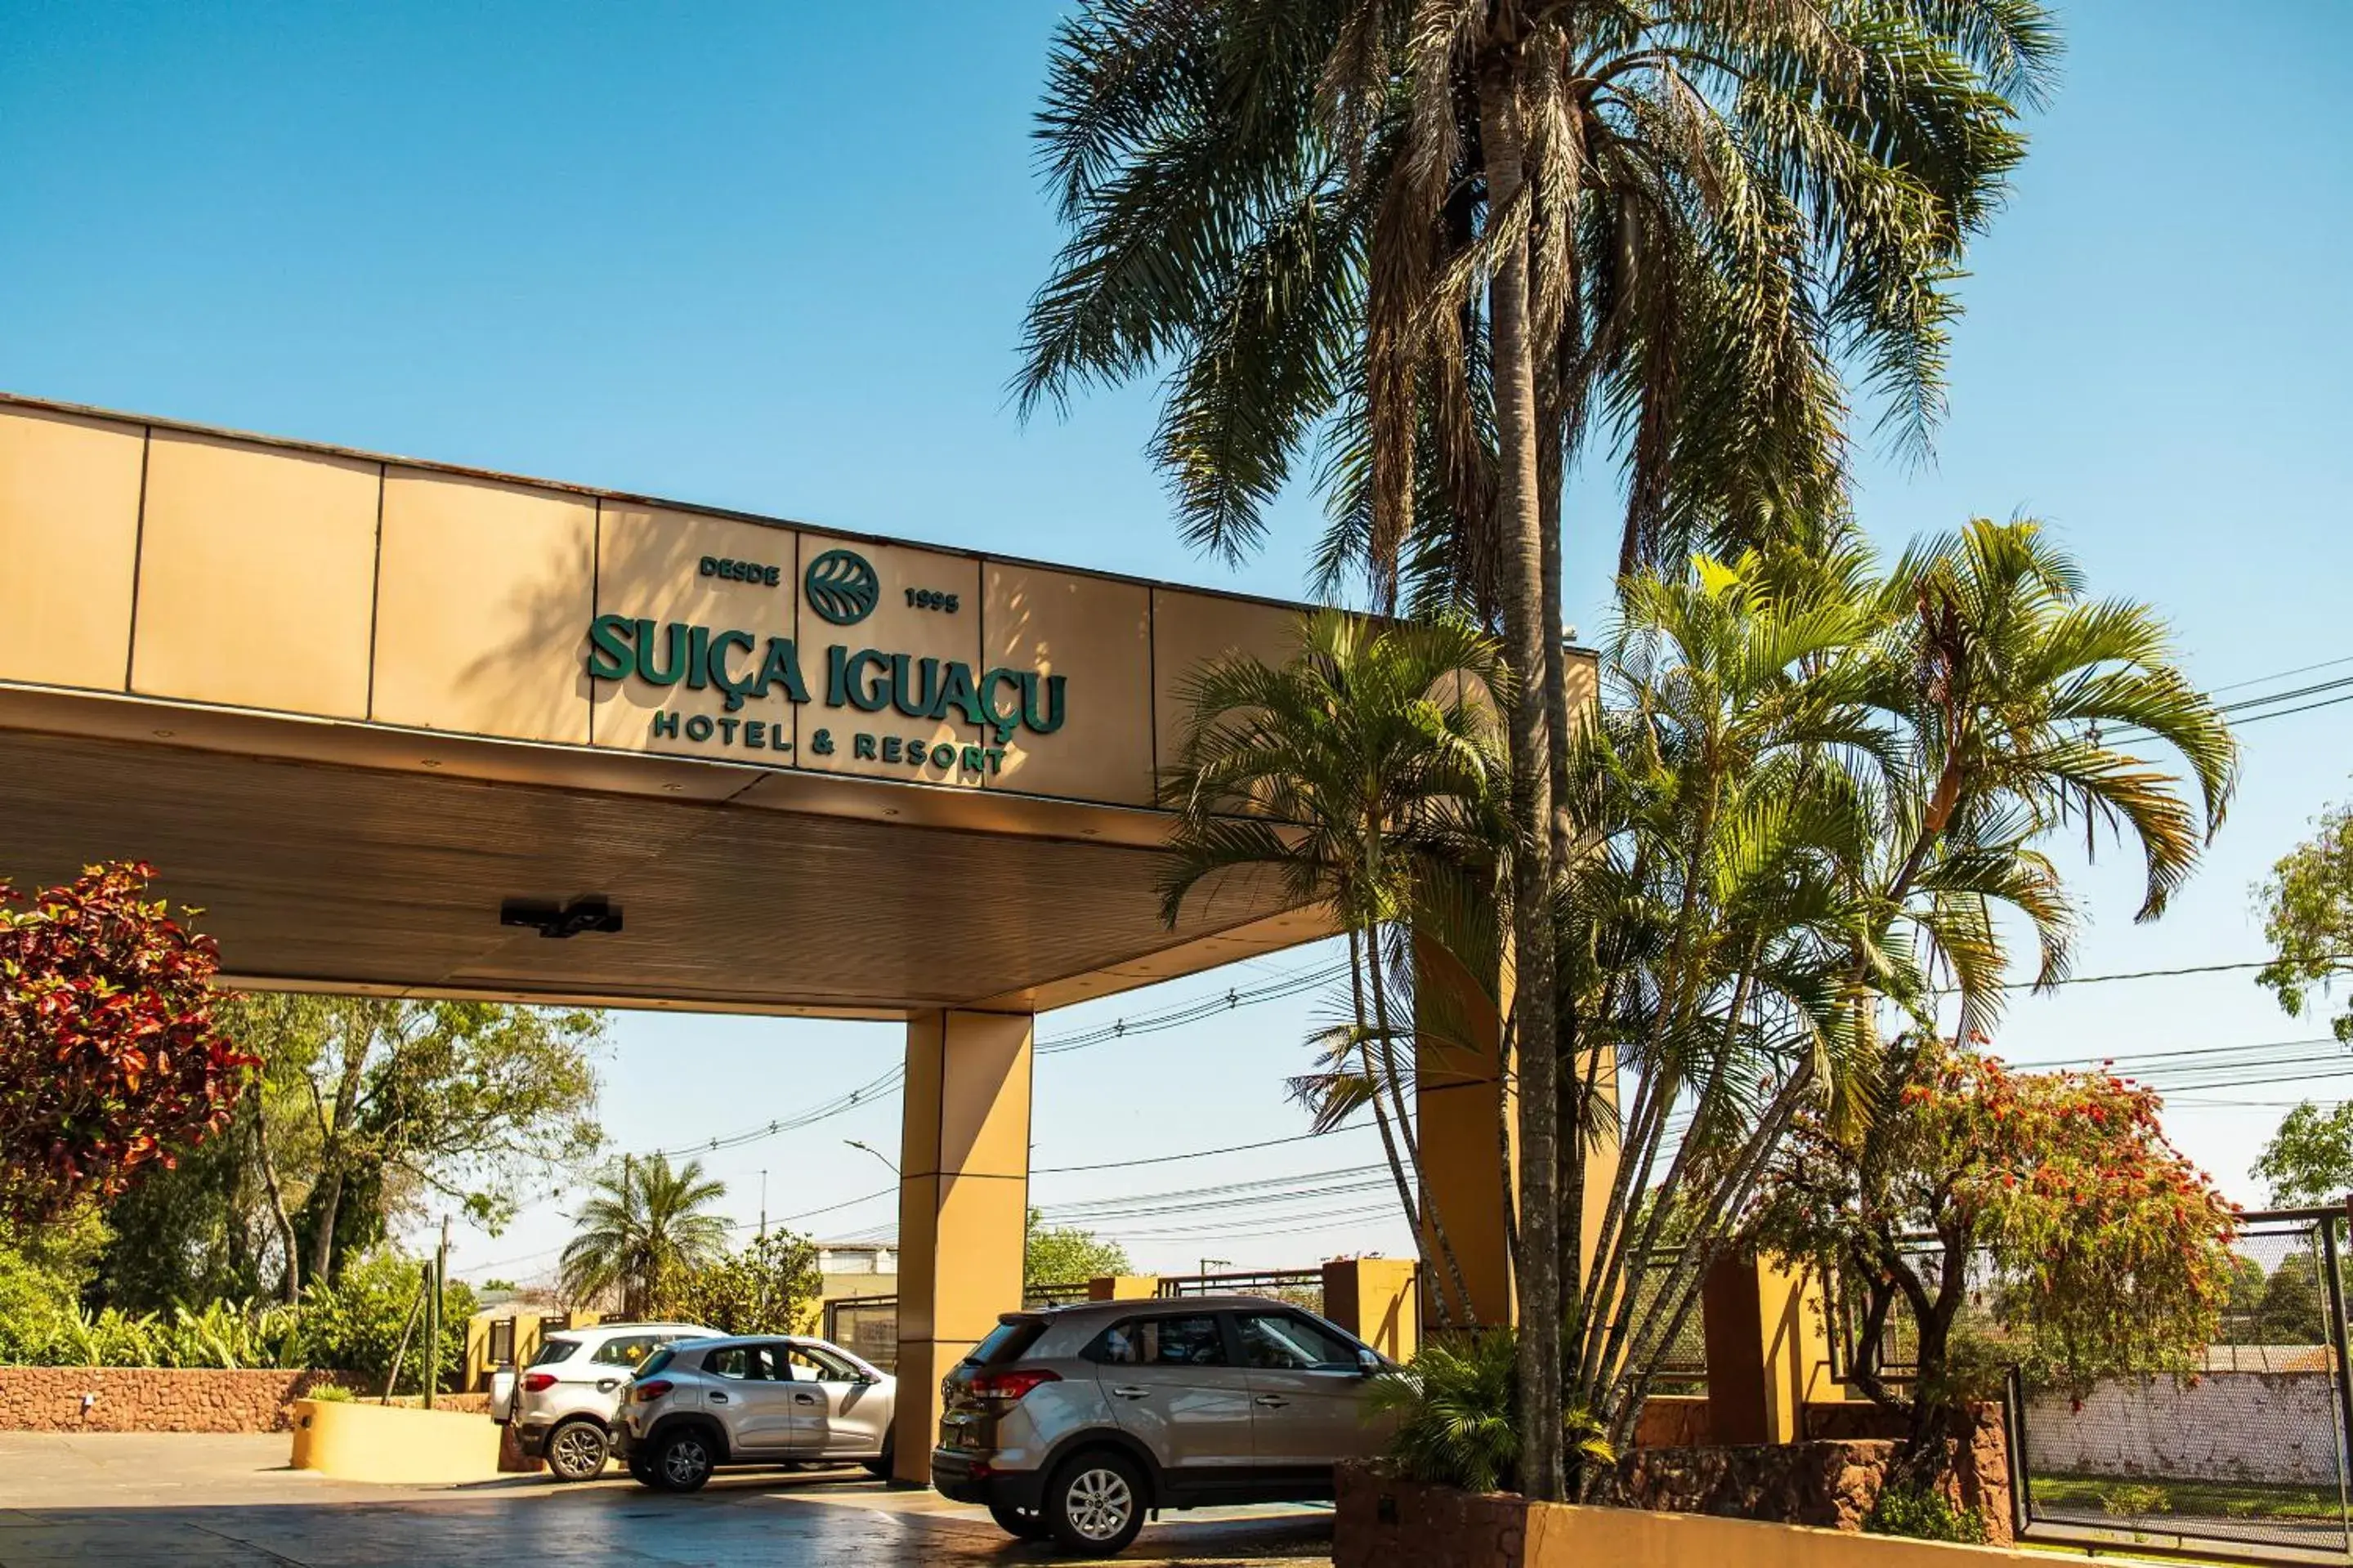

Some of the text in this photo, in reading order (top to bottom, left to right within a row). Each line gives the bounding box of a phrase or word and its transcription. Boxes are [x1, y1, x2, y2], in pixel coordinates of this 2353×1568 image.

[700, 556, 959, 613] DESDE 1995
[589, 614, 1067, 743] SUIÇA IGUAÇU
[655, 710, 1006, 774] HOTEL & RESORT
